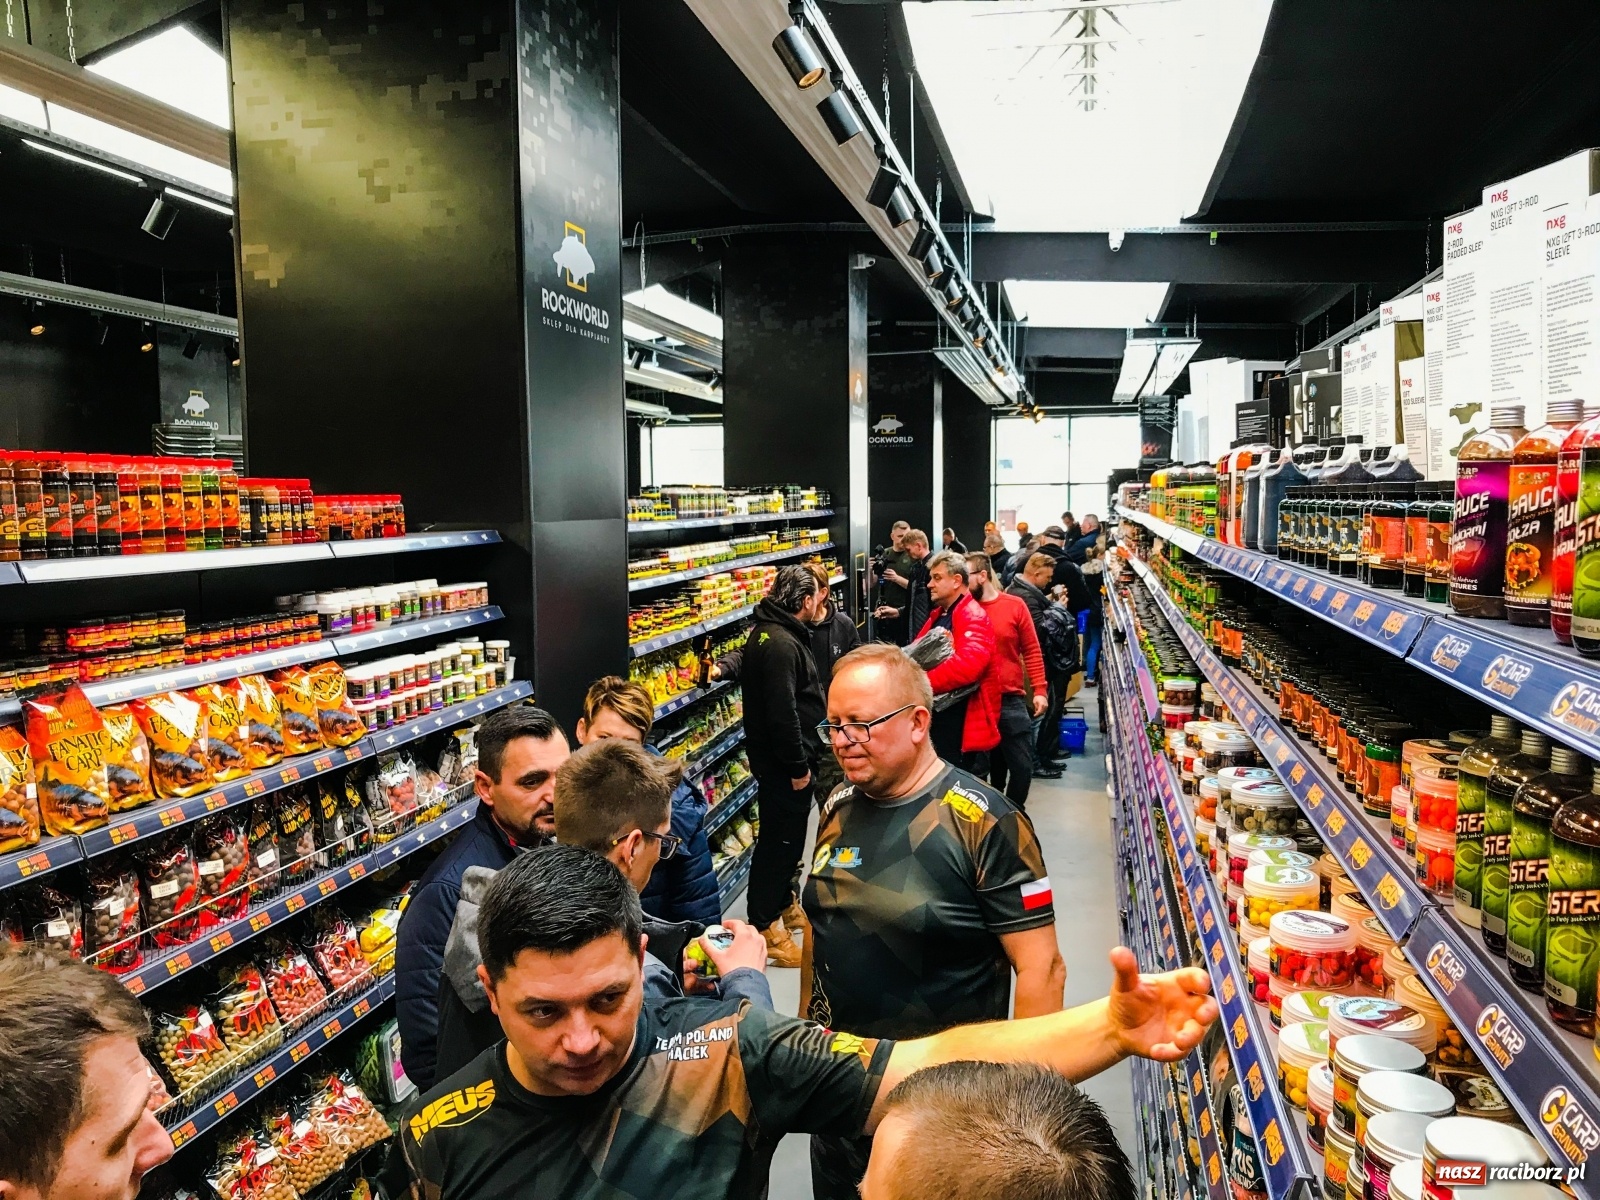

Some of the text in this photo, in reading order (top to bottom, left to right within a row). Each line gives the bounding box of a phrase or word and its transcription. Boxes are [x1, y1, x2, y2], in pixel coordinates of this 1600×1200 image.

[1490, 190, 1508, 203] nxg
[1490, 206, 1504, 220] NXG
[1518, 194, 1538, 210] 3-ROD
[1448, 222, 1462, 234] nxg
[1490, 216, 1512, 231] SLEEVE
[1546, 215, 1566, 230] nxg
[1546, 235, 1561, 249] NXG
[1562, 230, 1576, 245] 12FT
[1447, 244, 1468, 260] PADDED
[1546, 245, 1570, 262] SLEEVE
[1426, 292, 1440, 302] nxg
[542, 287, 609, 330] ROCKWORLD
[542, 316, 562, 329] SKLEP
[566, 324, 576, 334] DLA
[1454, 490, 1490, 520] AUCE
[1446, 640, 1470, 658] CARP
[1500, 660, 1531, 682] CARP
[66, 748, 102, 773] CARP
[1440, 952, 1464, 980] CARP
[656, 1026, 734, 1050] TEAM POLAND
[1494, 1018, 1524, 1052] CARP
[410, 1079, 496, 1142] MEUS
[1562, 1104, 1599, 1150] CARP
[1552, 1124, 1586, 1164] GRAVITY
